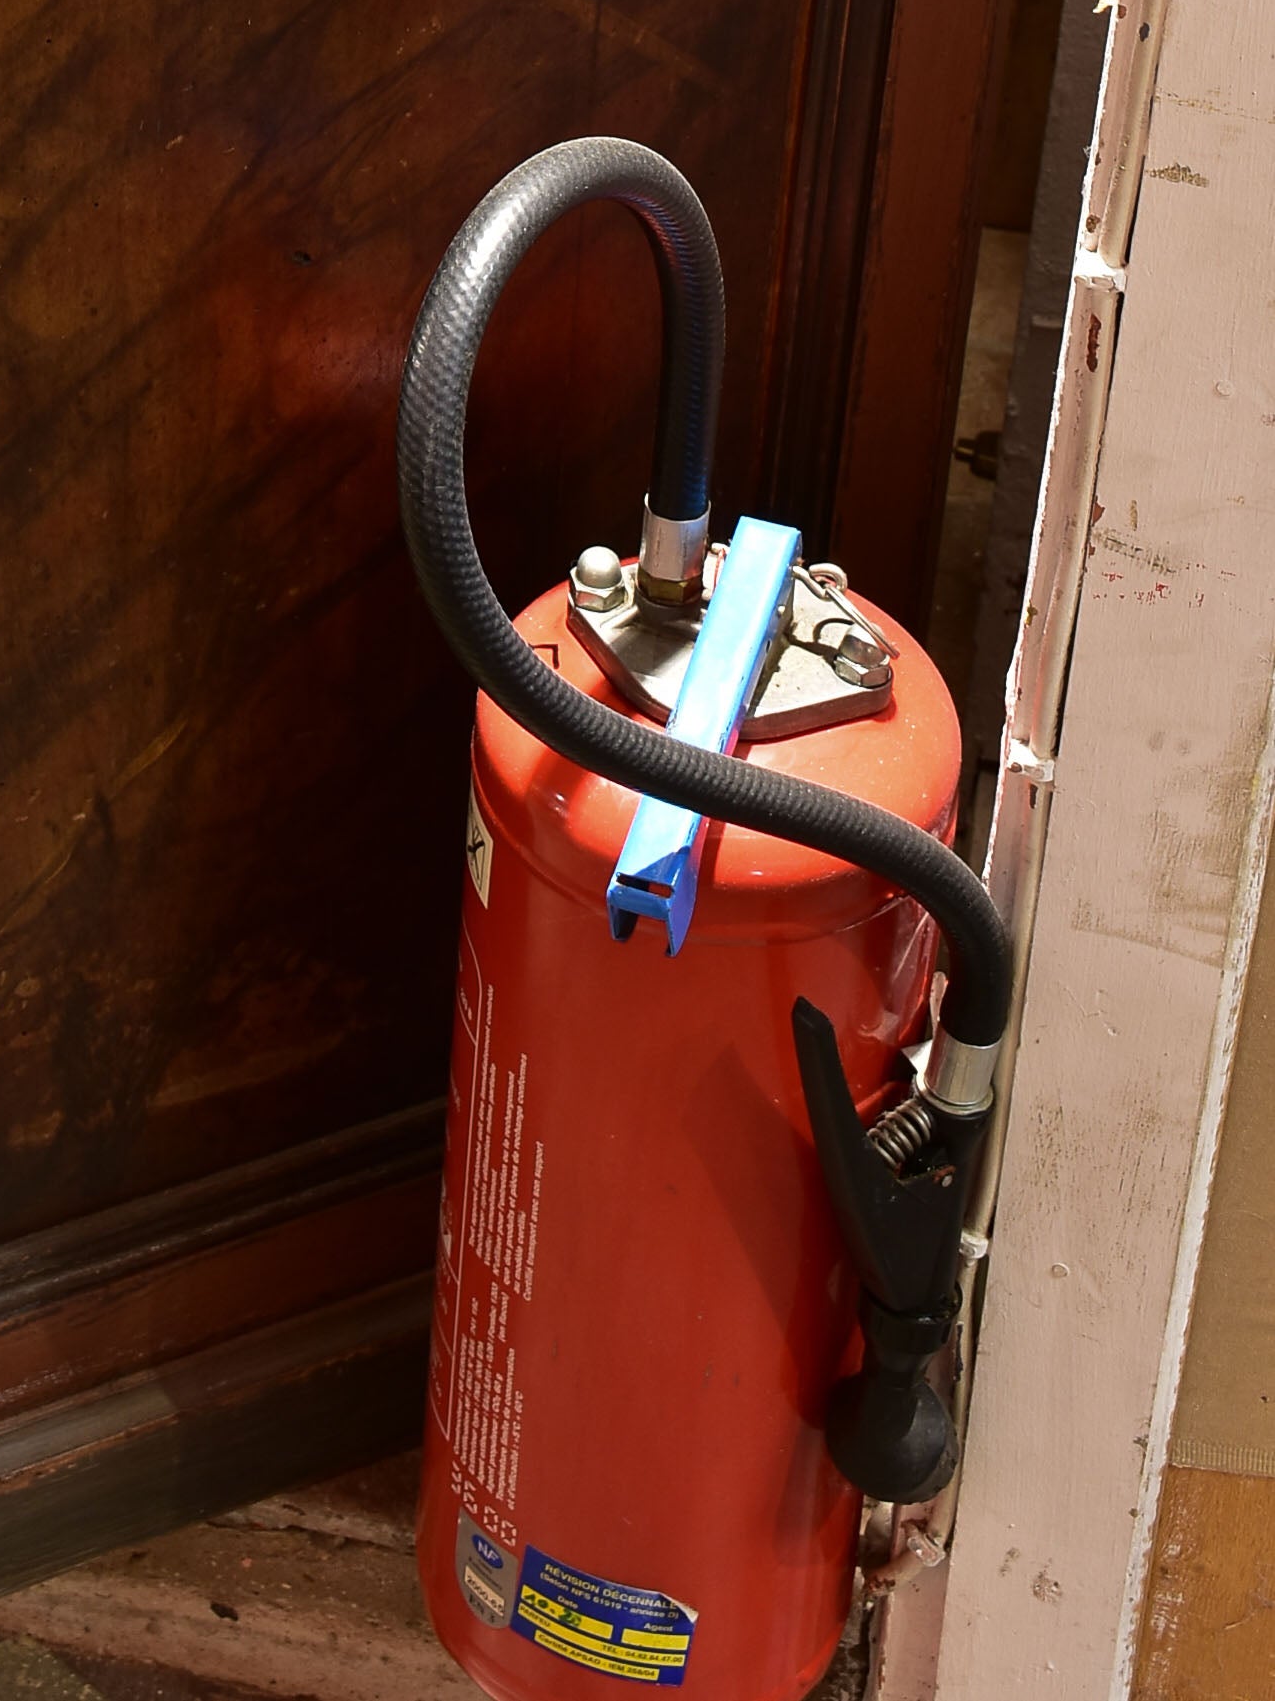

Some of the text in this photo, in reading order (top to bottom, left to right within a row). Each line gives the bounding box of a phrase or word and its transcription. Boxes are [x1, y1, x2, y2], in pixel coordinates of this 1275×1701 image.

[478, 1540, 500, 1561] NF
[544, 1563, 678, 1610] RÉVISION DÉCENNALE
[557, 1595, 579, 1609] Date
[629, 1606, 666, 1618] annexe
[643, 1622, 674, 1632] Agent
